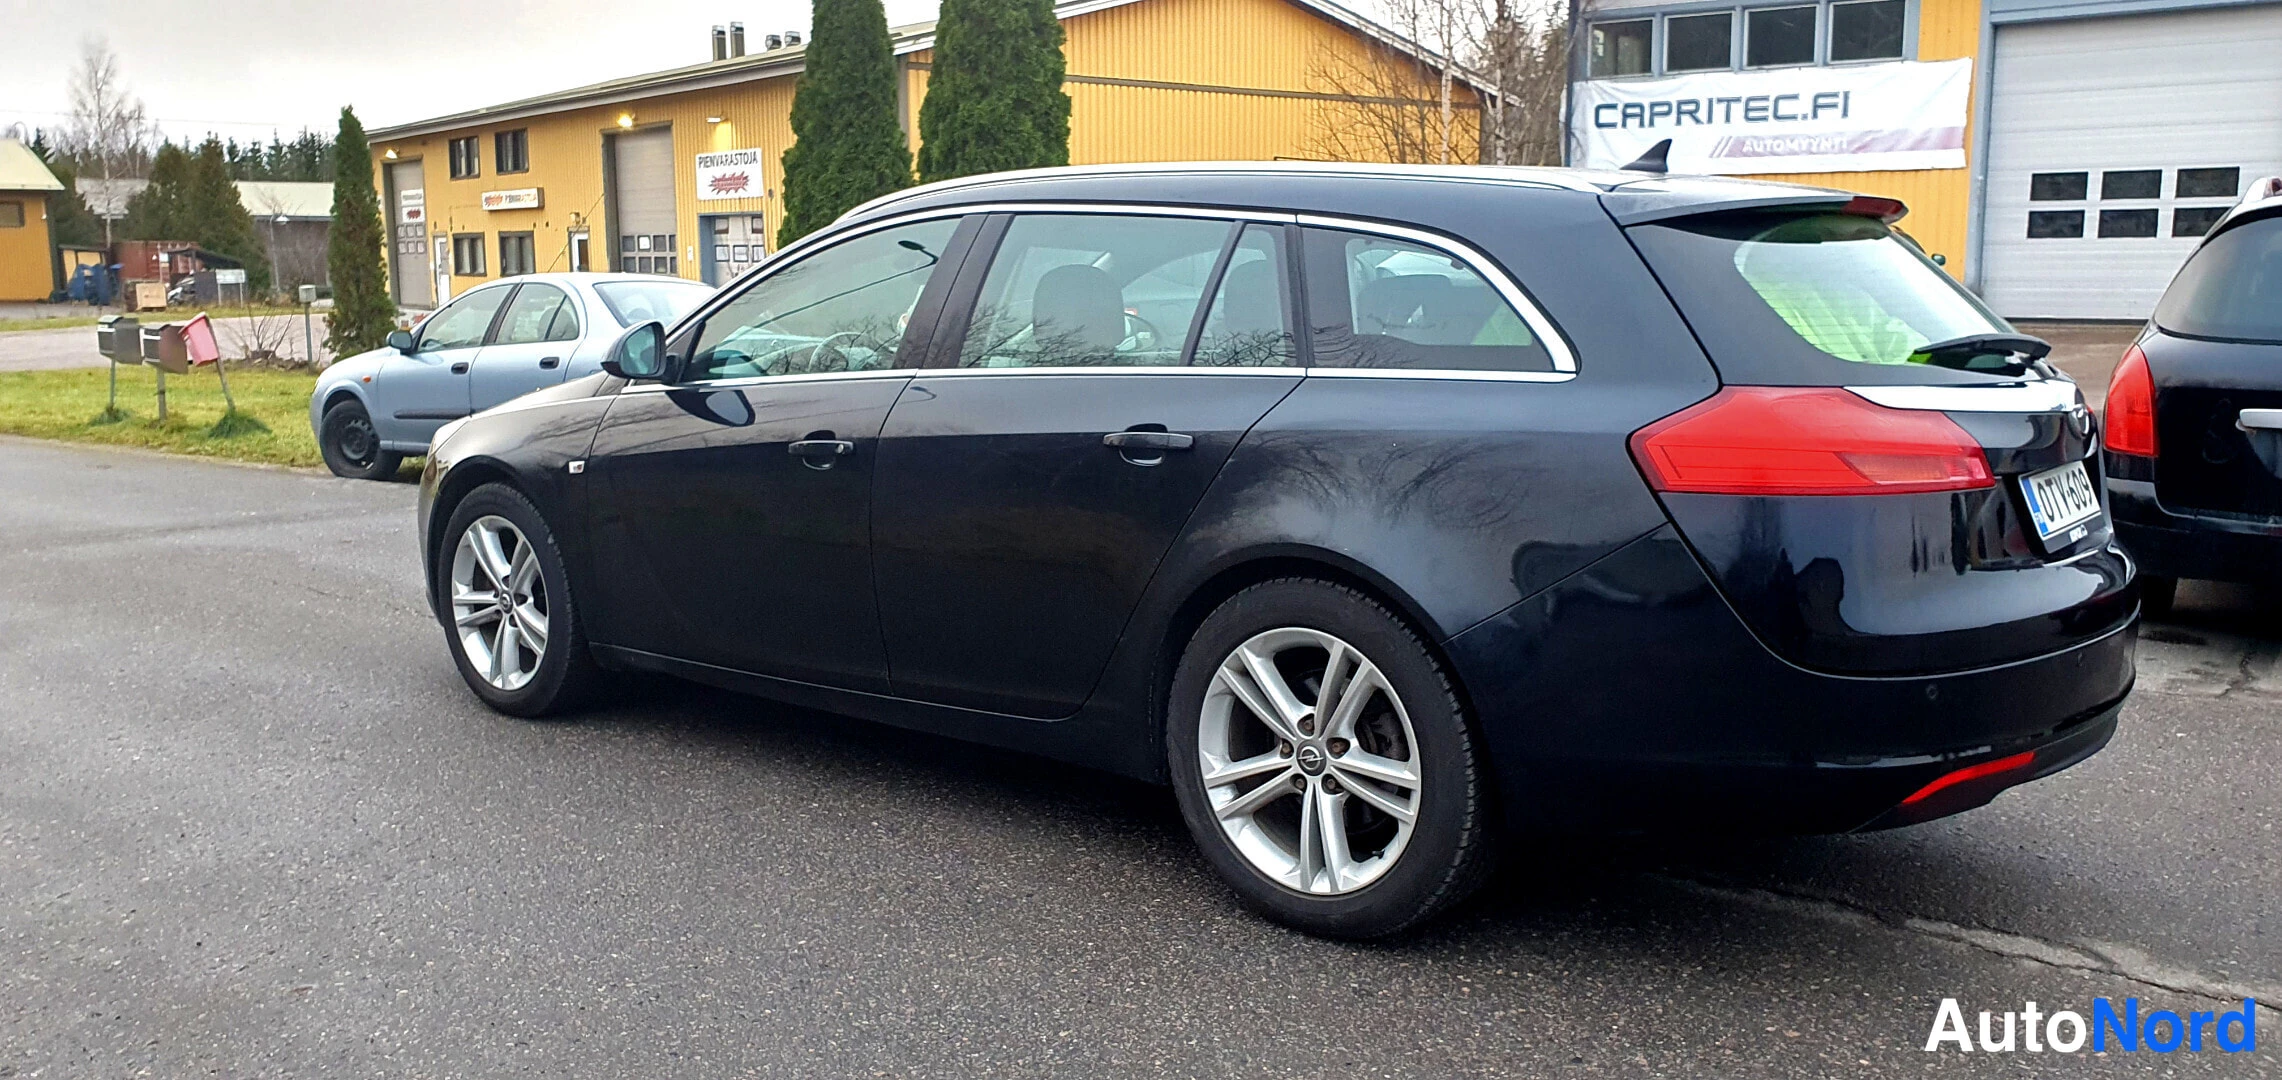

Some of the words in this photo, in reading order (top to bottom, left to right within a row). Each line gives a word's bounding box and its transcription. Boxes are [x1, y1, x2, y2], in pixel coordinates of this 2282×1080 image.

[1594, 91, 1851, 129] CAPRITEC.FI
[1742, 137, 1848, 153] AUTOMYYNTI
[698, 151, 758, 168] PIENVARASTOJA
[2037, 467, 2093, 522] OTY-609
